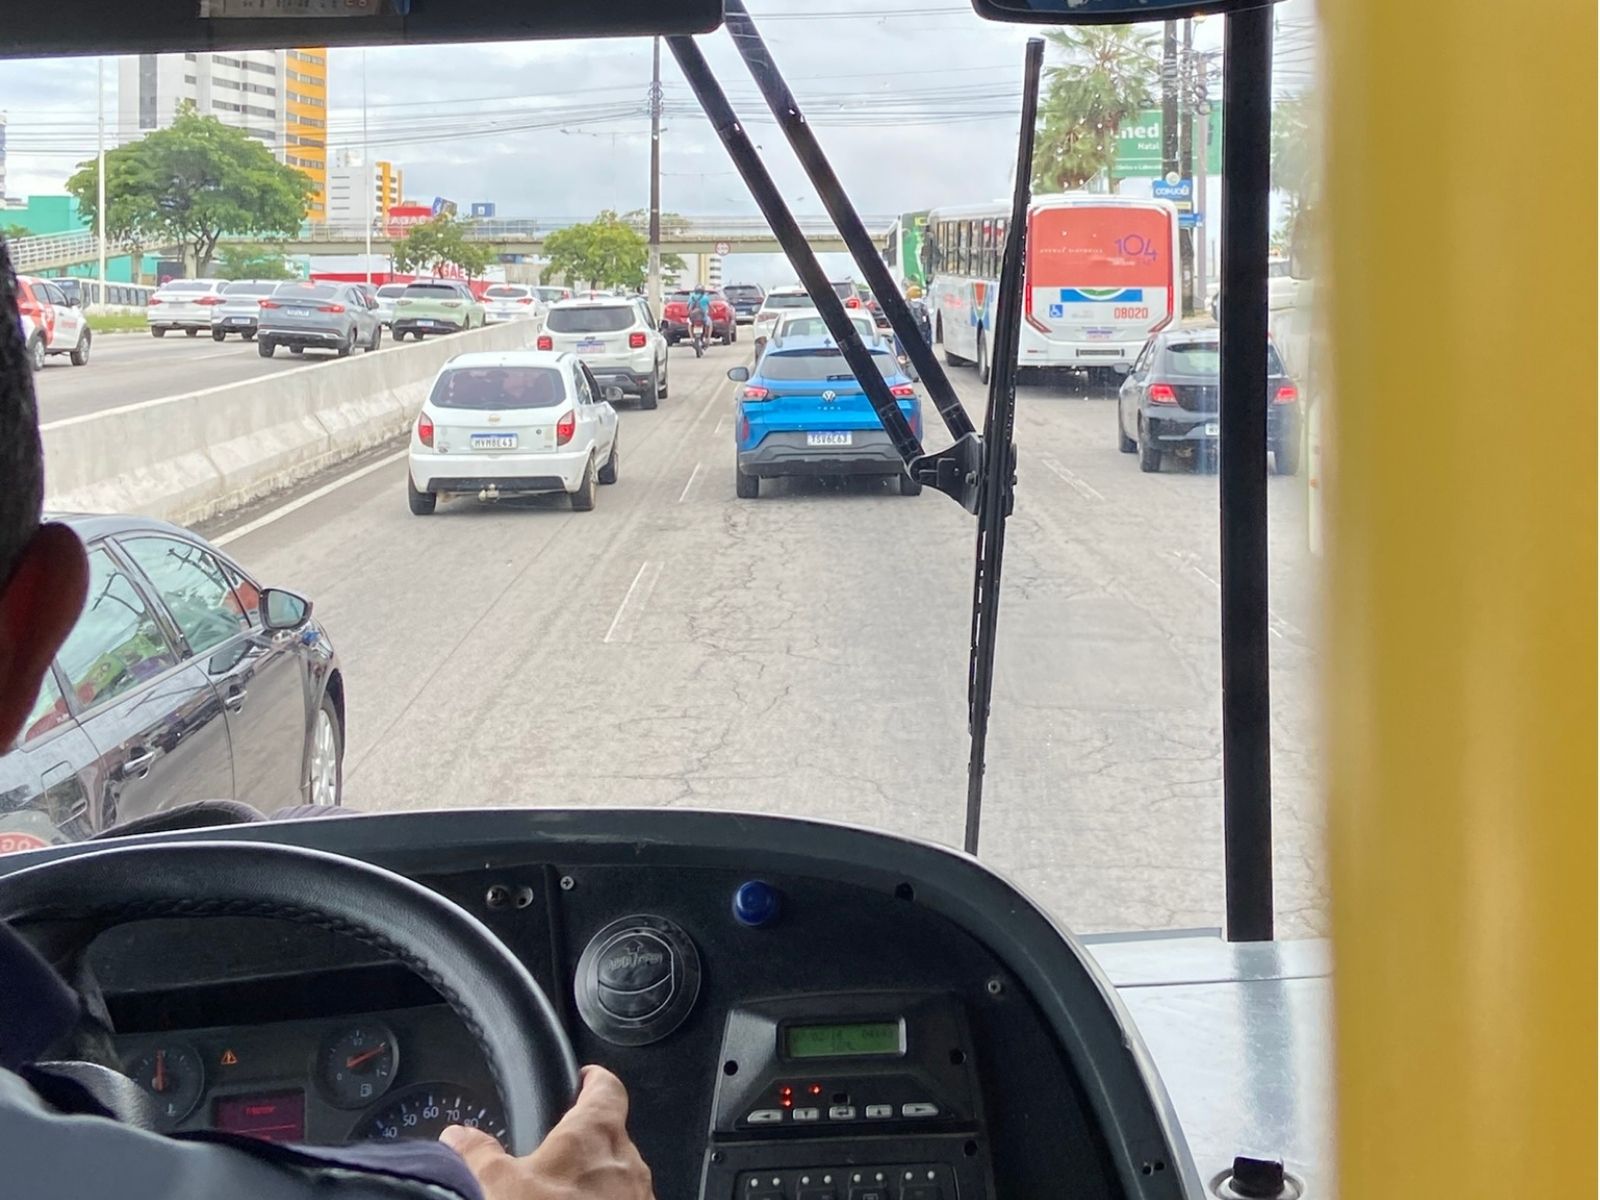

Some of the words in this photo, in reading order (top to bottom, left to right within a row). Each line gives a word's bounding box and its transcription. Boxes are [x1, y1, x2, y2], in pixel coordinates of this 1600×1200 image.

[1114, 122, 1160, 139] med
[1137, 142, 1160, 150] Natal
[1115, 234, 1158, 261] 104
[1113, 307, 1149, 319] 08020
[422, 1106, 439, 1119] 60
[445, 1109, 460, 1121] 70
[402, 1113, 417, 1127] 50
[463, 1117, 479, 1129] 80
[382, 1126, 398, 1138] 40
